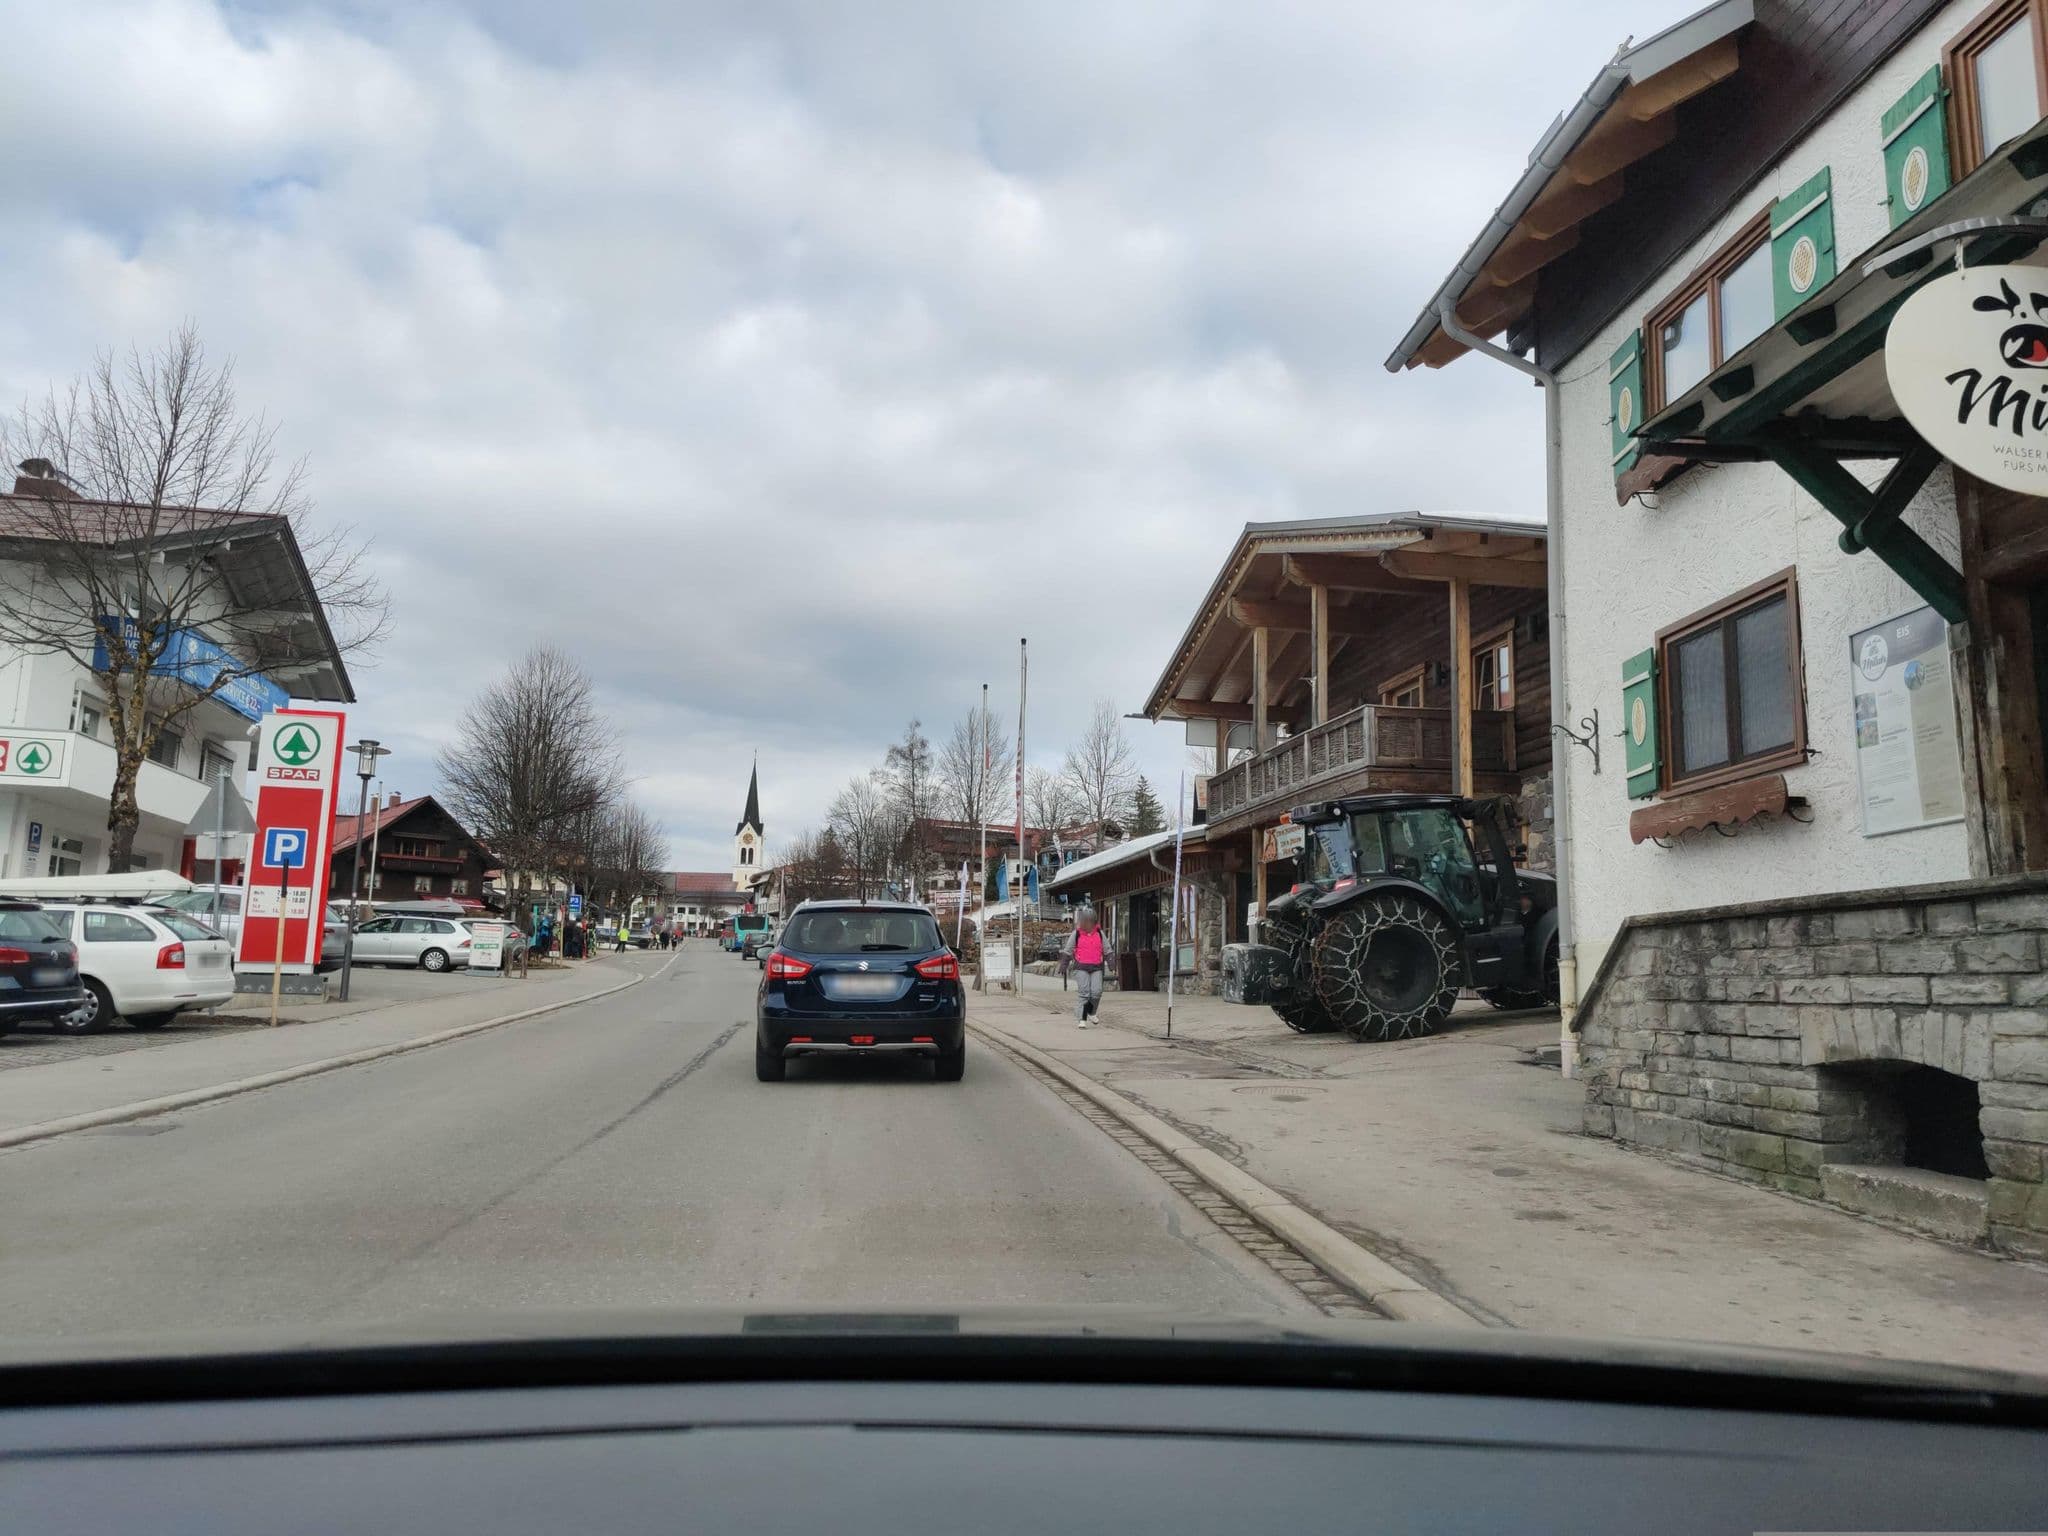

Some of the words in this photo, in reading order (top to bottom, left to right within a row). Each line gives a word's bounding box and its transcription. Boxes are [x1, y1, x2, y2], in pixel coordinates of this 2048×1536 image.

[1945, 368, 2048, 437] Mi
[1993, 444, 2042, 459] WALSER
[2037, 463, 2048, 473] M
[1896, 624, 1910, 639] EIS
[268, 767, 319, 780] SPAR
[273, 833, 299, 862] P
